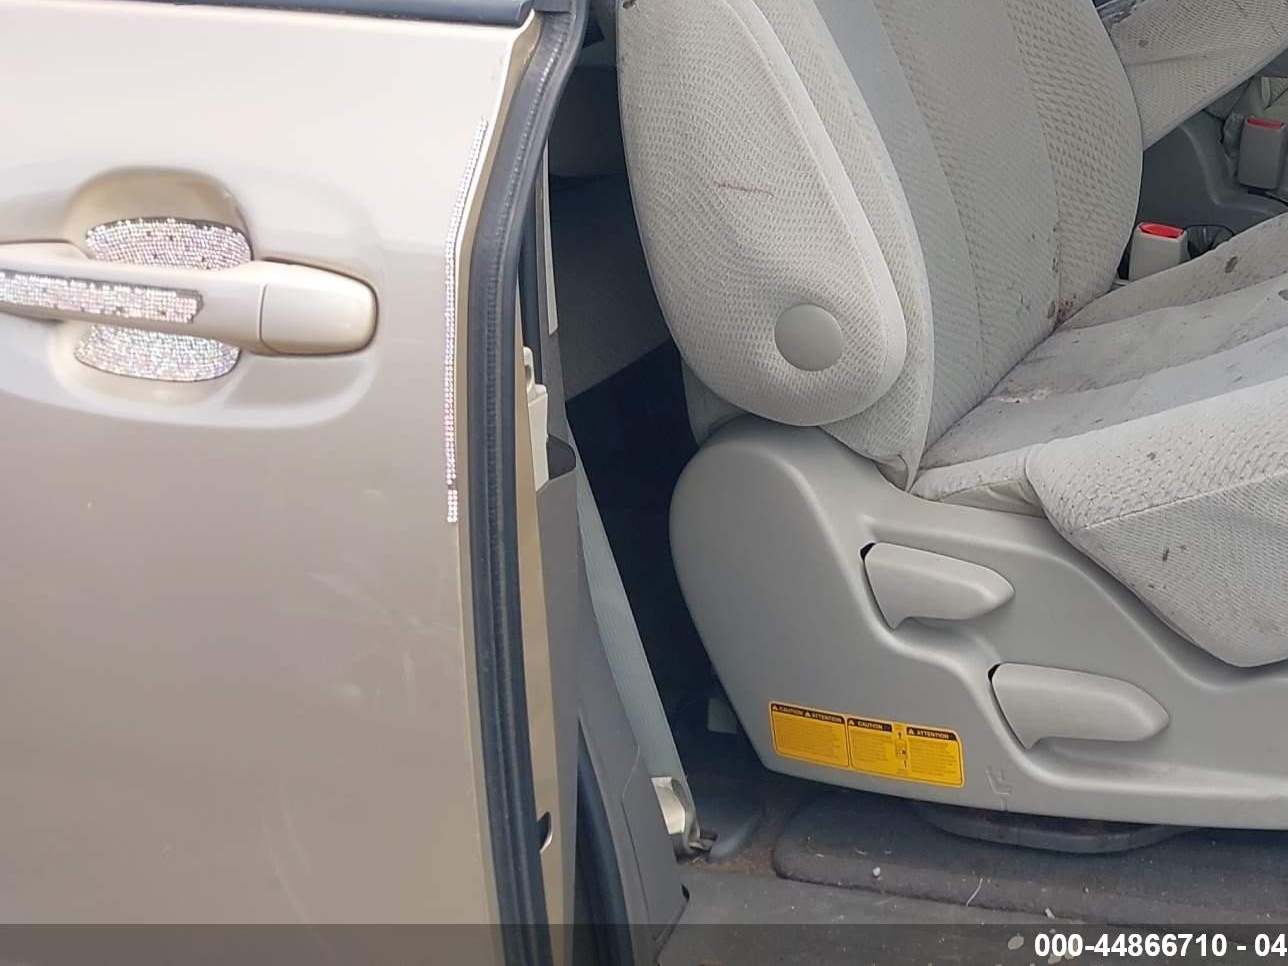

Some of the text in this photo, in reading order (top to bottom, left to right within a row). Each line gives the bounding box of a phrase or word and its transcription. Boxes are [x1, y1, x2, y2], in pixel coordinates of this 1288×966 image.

[778, 706, 804, 716] CAUTION
[857, 721, 883, 730] CAUTION
[916, 730, 949, 739] ATTENTION
